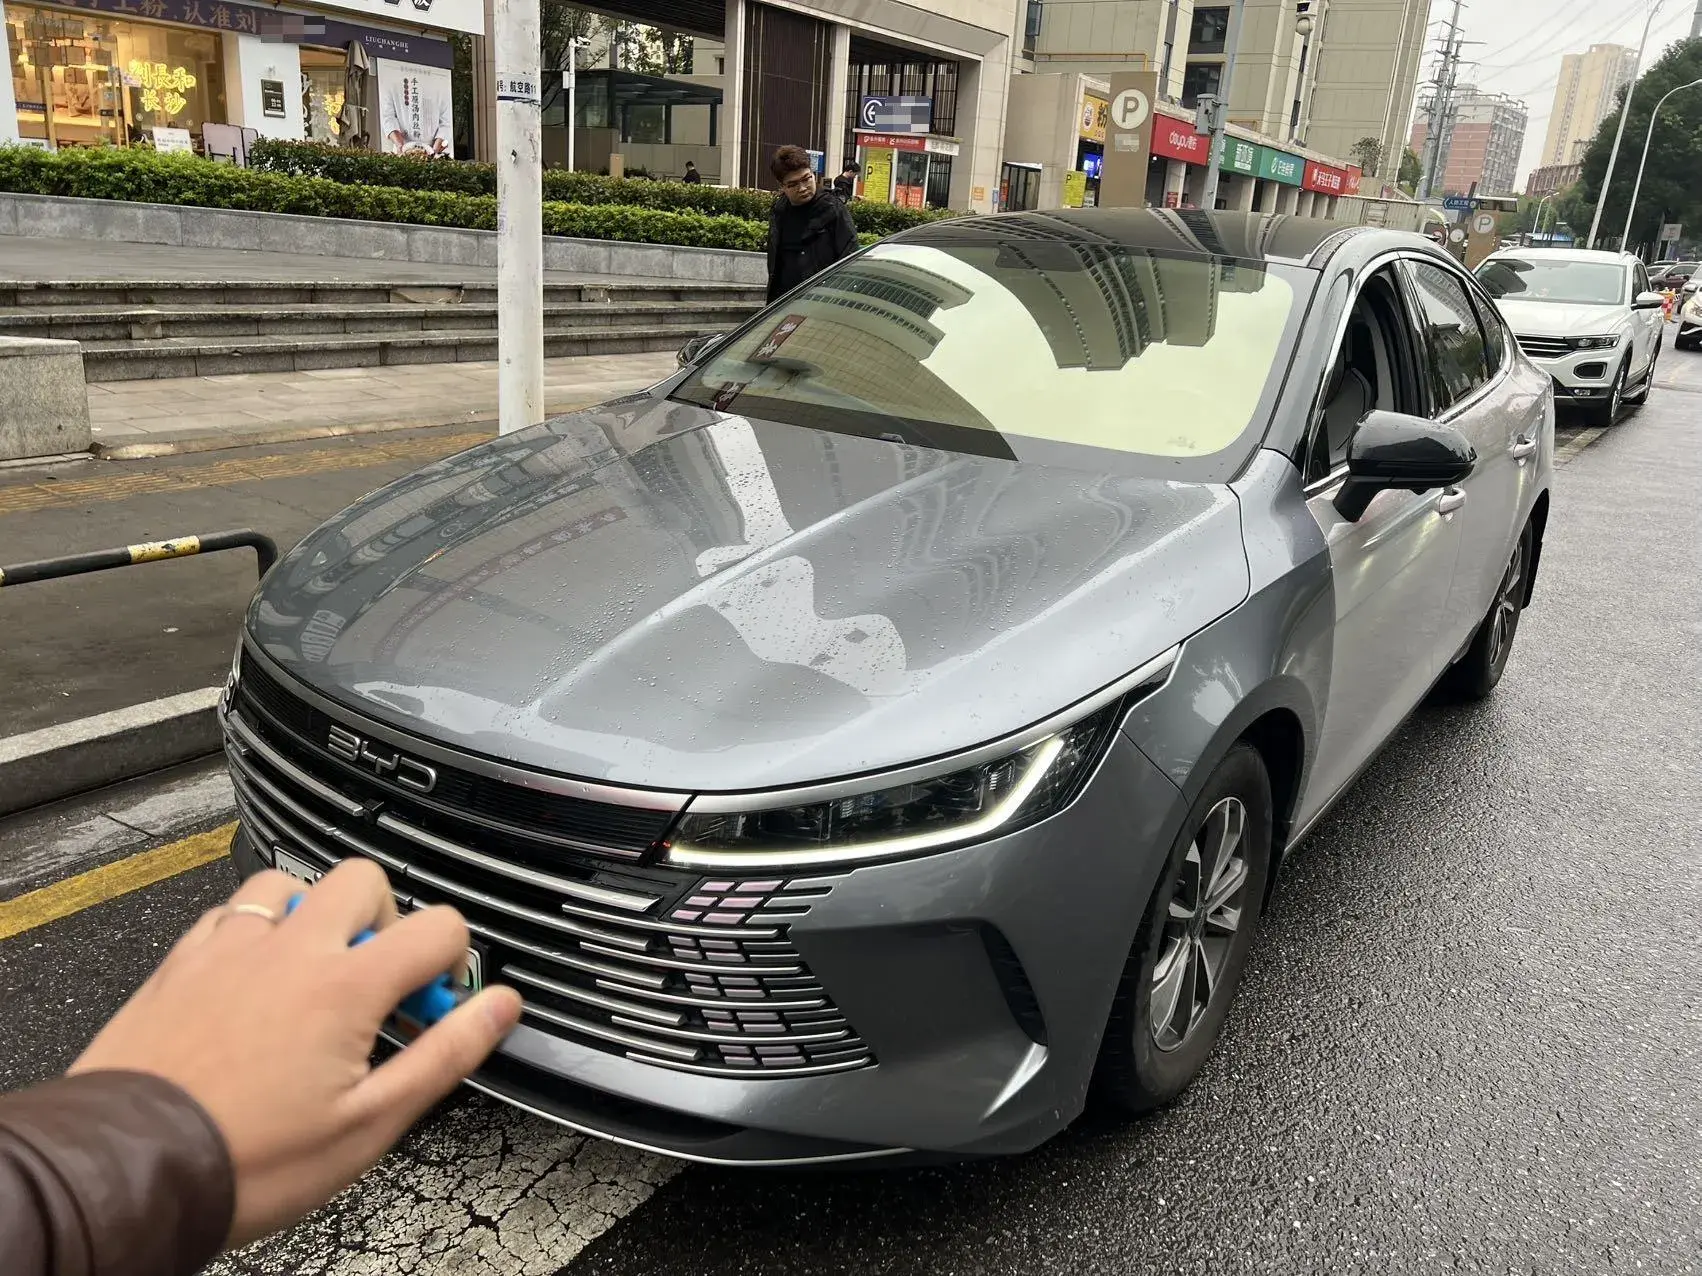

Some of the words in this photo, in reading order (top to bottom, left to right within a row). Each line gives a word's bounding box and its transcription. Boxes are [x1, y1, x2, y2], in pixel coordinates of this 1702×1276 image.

[365, 35, 409, 48] LIUCHANGHE
[1122, 96, 1140, 123] P
[328, 725, 438, 793] BYD
